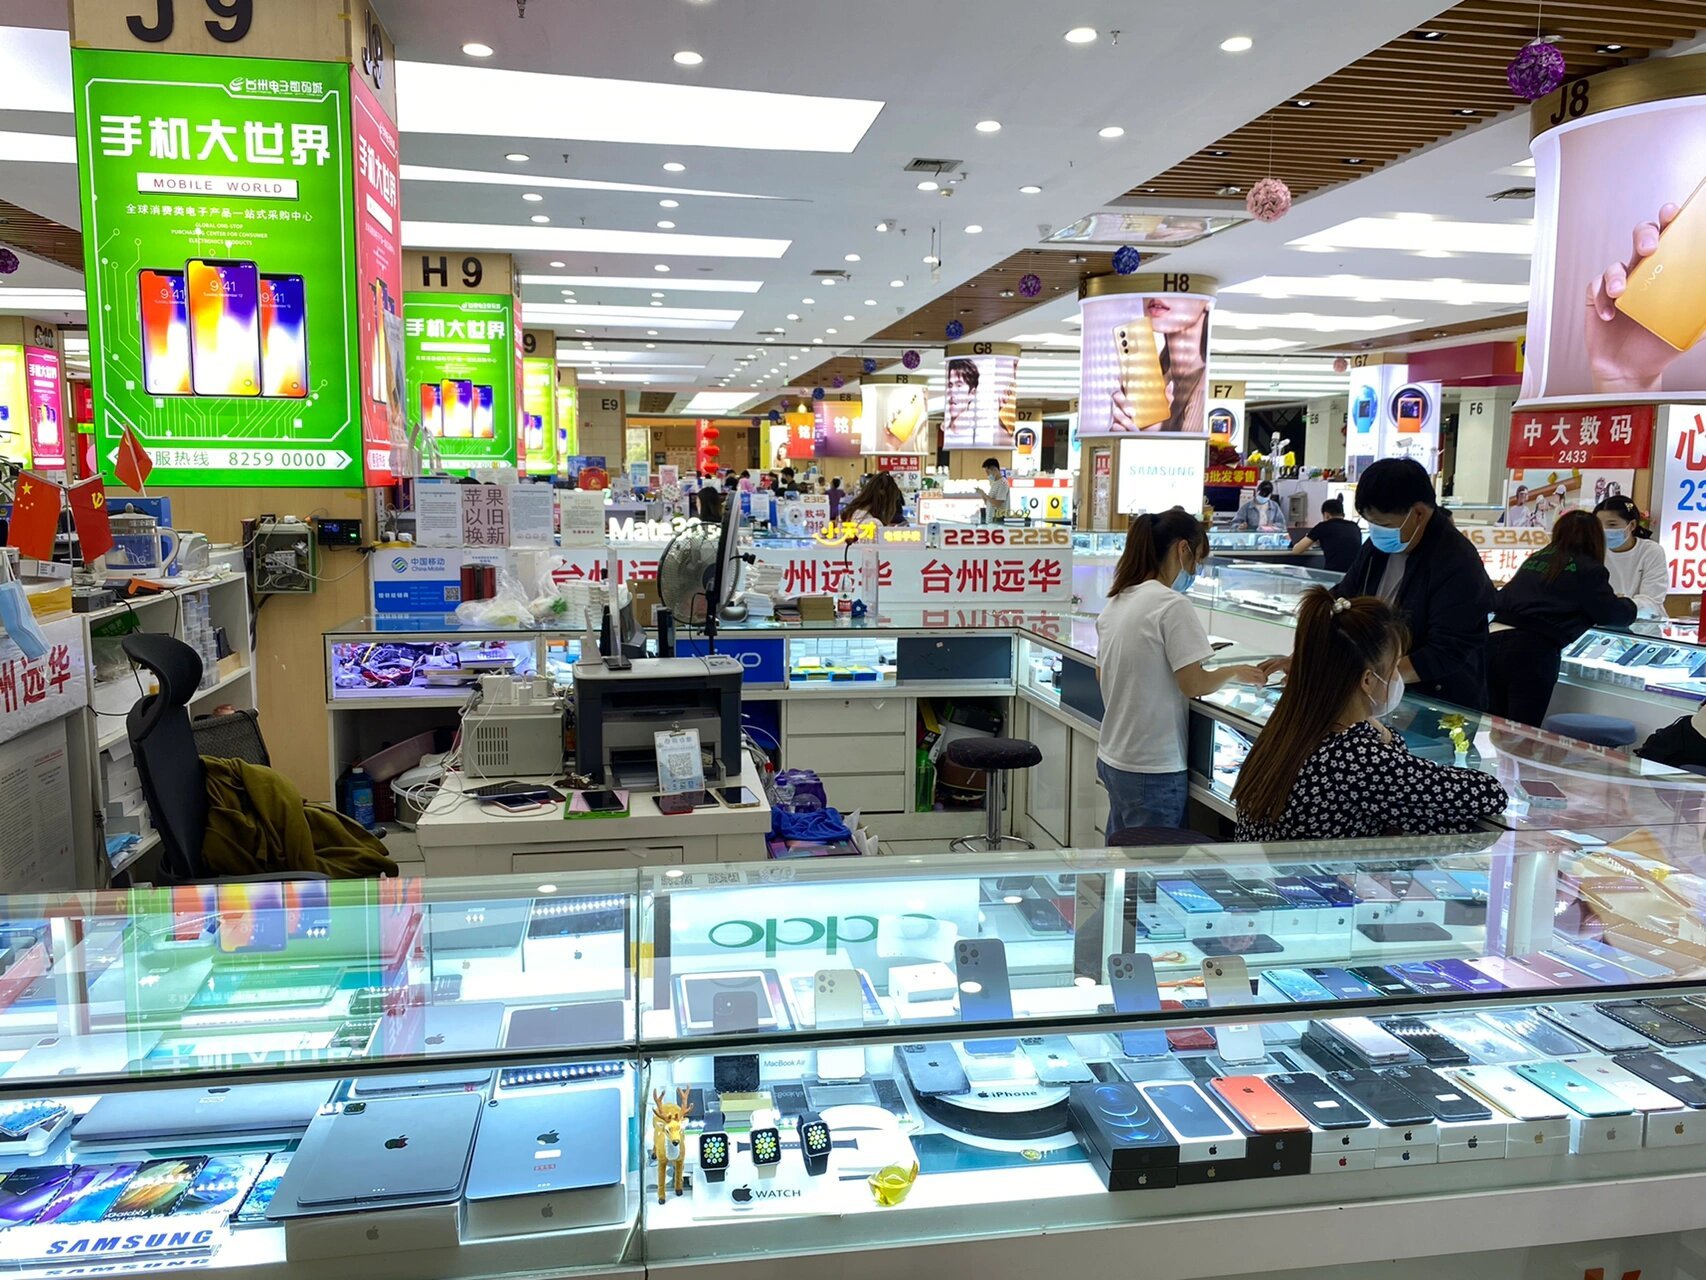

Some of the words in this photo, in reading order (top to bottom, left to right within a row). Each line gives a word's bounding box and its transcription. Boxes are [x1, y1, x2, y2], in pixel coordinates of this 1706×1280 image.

[1550, 79, 1590, 125] J8
[100, 114, 331, 166] 手机大世界
[153, 178, 213, 191] MOBILE
[227, 181, 283, 194] WORLD
[125, 203, 313, 222] 全球消费类电子产品一站式采购中心
[209, 280, 236, 293] 9:41
[1163, 274, 1189, 292] H8
[405, 318, 505, 340] 手机大世界
[973, 343, 992, 355] G8
[1354, 353, 1369, 367] G7
[1214, 385, 1233, 398] F7
[602, 399, 618, 411] E9
[1470, 402, 1483, 416] F6
[1523, 414, 1633, 448] 中大数码
[228, 451, 273, 467] 8259
[281, 452, 327, 468] 0000
[1558, 450, 1588, 464] 2433
[1129, 465, 1195, 477] SAMSUNG
[1204, 470, 1256, 483] 批发零售
[464, 488, 504, 506] 苹果
[465, 508, 504, 525] 以旧
[465, 526, 505, 545] 换新
[944, 529, 1005, 545] 2236
[1008, 530, 1069, 545] 2236
[1492, 530, 1544, 544] 2348
[411, 557, 446, 566] 中国移动
[921, 559, 1062, 593] 台州远华
[763, 1060, 795, 1068] MacBook
[991, 1088, 1037, 1099] iPhone
[756, 1188, 801, 1198] WATCH
[46, 1229, 214, 1255] SAMSUNG
